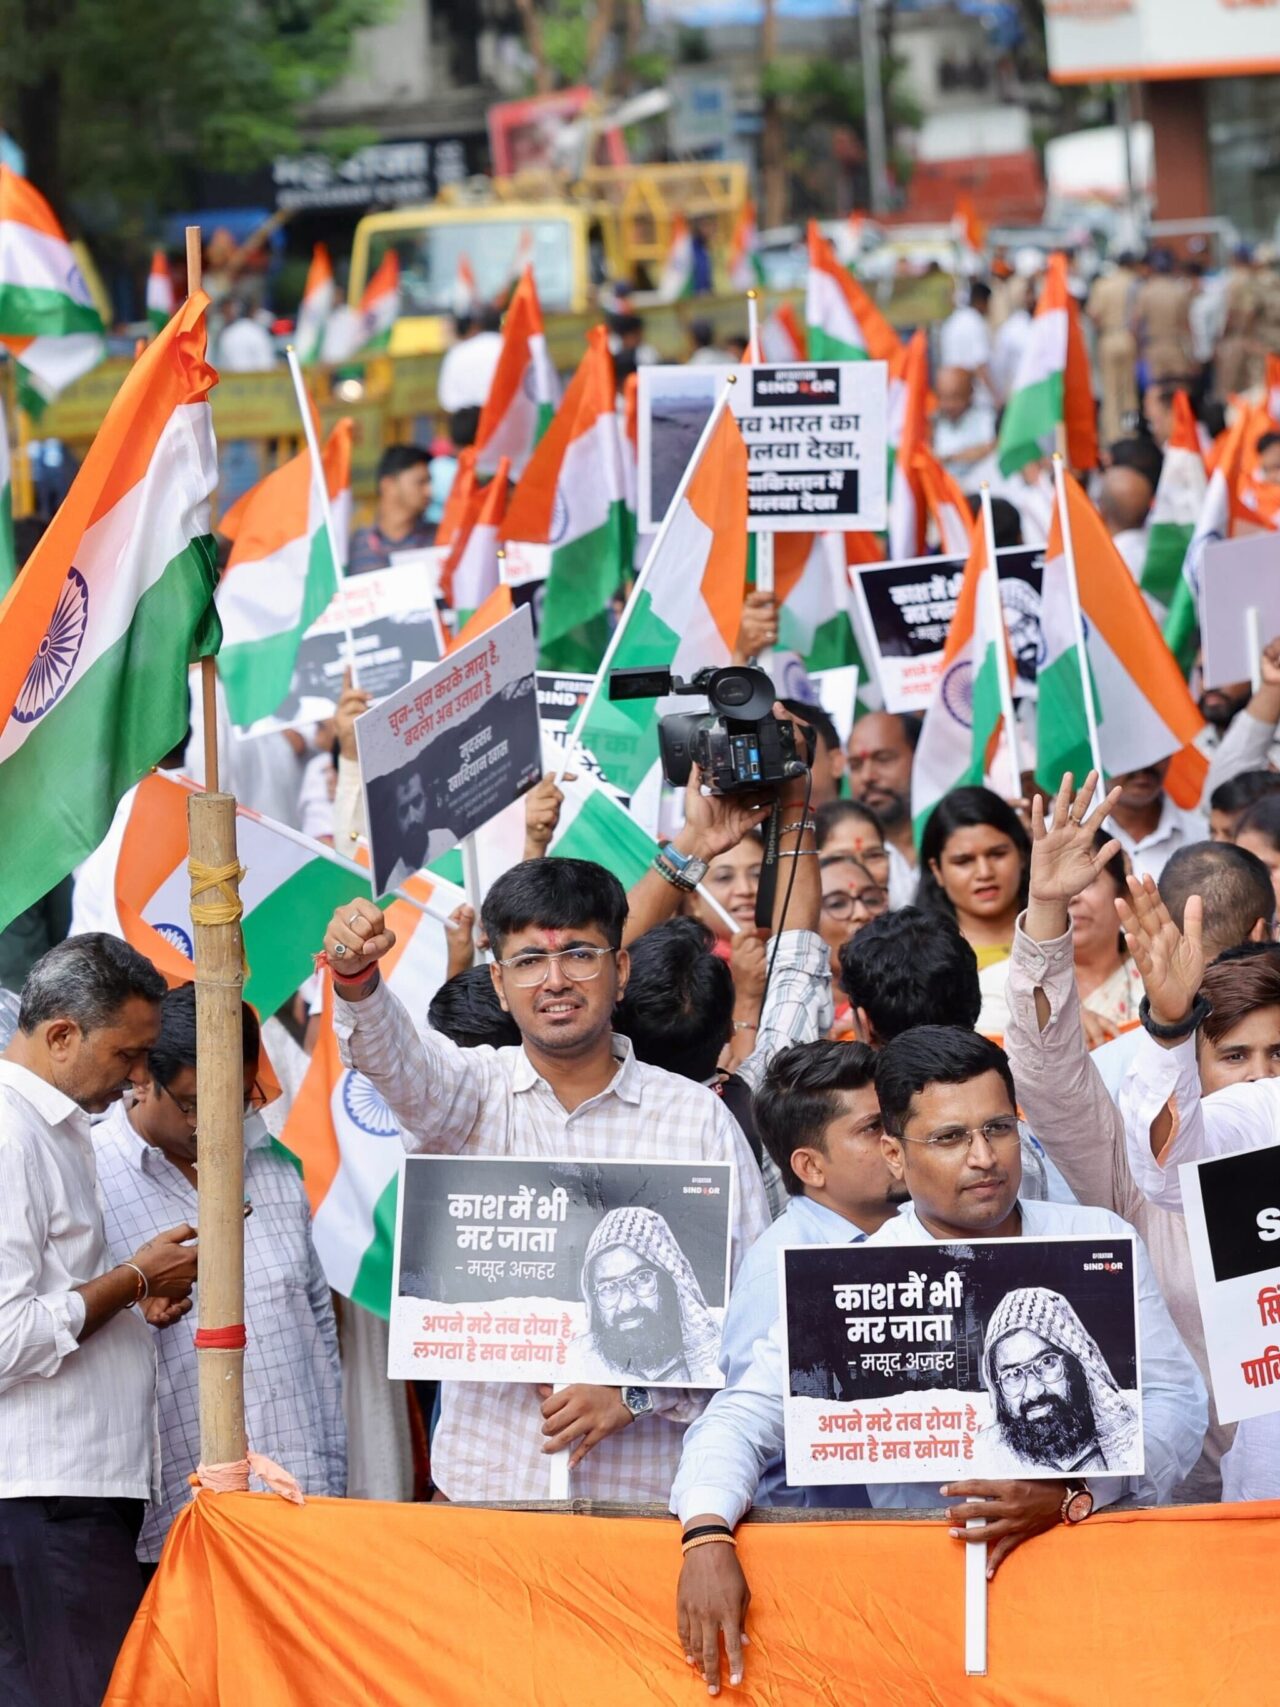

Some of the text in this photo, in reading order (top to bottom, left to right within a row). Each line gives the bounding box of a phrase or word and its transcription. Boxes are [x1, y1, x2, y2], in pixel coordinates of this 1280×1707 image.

[769, 414, 822, 433] भारत
[829, 414, 860, 432] का
[747, 436, 860, 463] लवा देखा,
[388, 688, 433, 737] चुन-चुन
[434, 666, 463, 698] करके
[464, 651, 488, 679] मारा
[403, 670, 492, 746] बदला अब उतारा है
[448, 1184, 569, 1222] काश मैं भी
[456, 1225, 557, 1252] मर जाता
[467, 1260, 506, 1283] मसूद
[509, 1260, 556, 1280] अज़हर
[833, 1270, 963, 1311] काश मैं भी
[422, 1311, 576, 1340] अपने मरे तब रोया है,
[845, 1315, 953, 1344] मर जाता
[413, 1336, 568, 1364] लगता है सब खोया है
[860, 1353, 901, 1377] मसूद
[905, 1351, 955, 1371] अज़हर
[818, 1403, 982, 1433] अपने मरे तब रोया है,
[811, 1432, 974, 1462] लगता है सब खोया है
